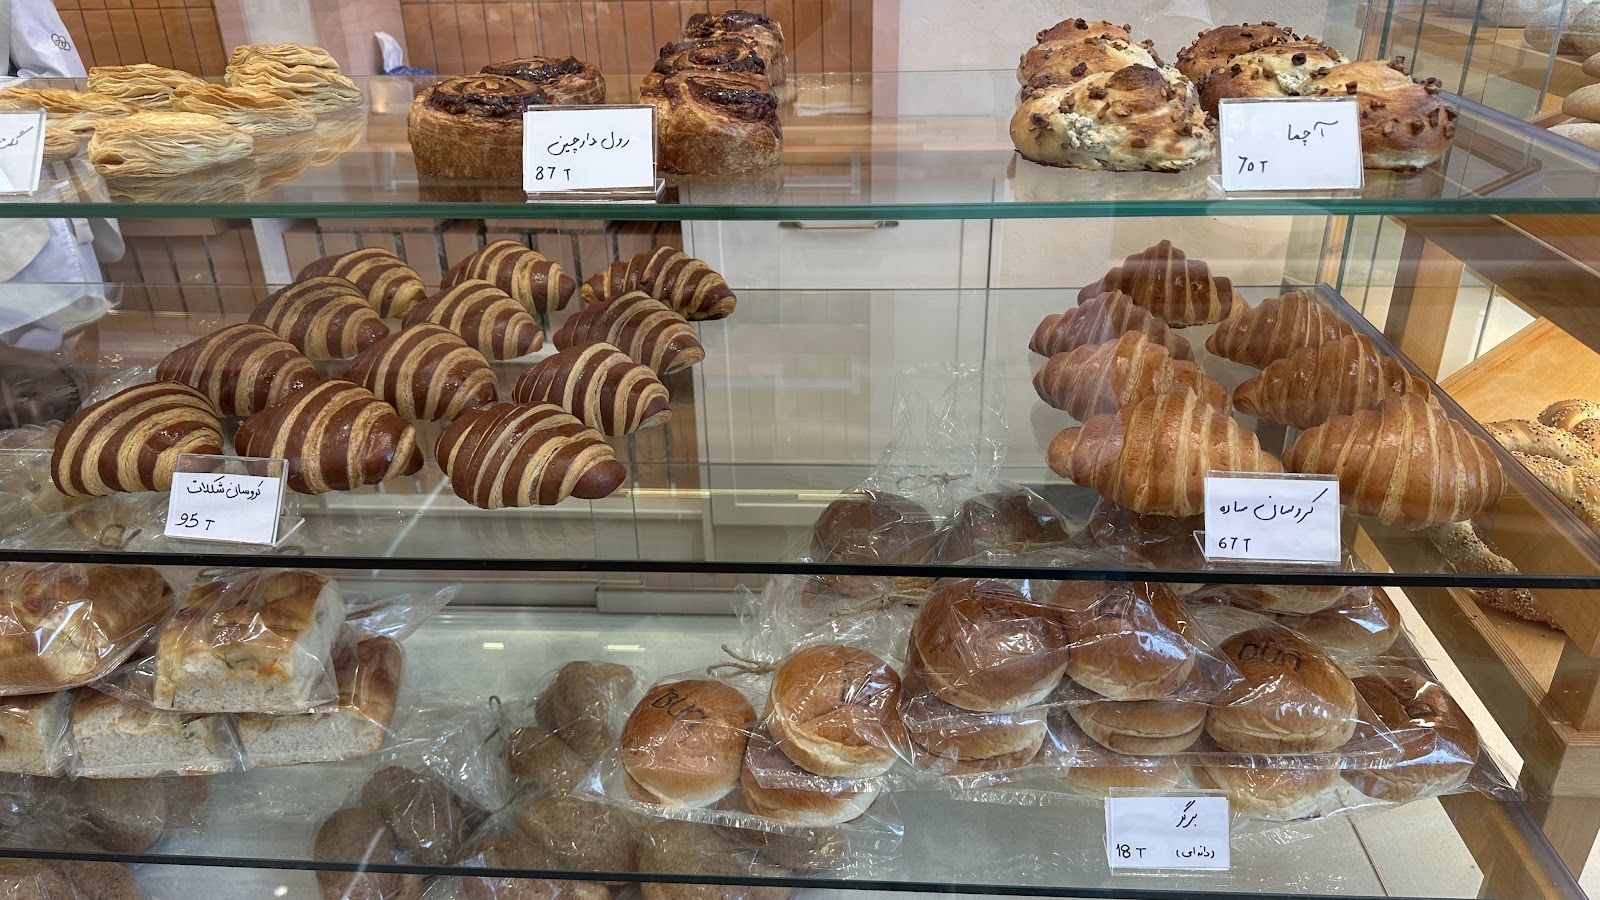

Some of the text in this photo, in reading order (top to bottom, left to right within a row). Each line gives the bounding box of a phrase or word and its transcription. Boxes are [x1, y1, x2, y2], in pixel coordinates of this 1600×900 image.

[547, 131, 630, 156] رول دارچین
[1287, 120, 1339, 146] آچما
[535, 165, 571, 181] 87 T
[1238, 155, 1268, 174] 70 T
[186, 475, 264, 501] کروسان شکلات
[1219, 487, 1329, 524] کروسان ساده
[175, 512, 215, 531] 95 T
[1218, 537, 1251, 552] 67 T
[1175, 799, 1198, 828] برگر
[1115, 843, 1147, 859] 18 T
